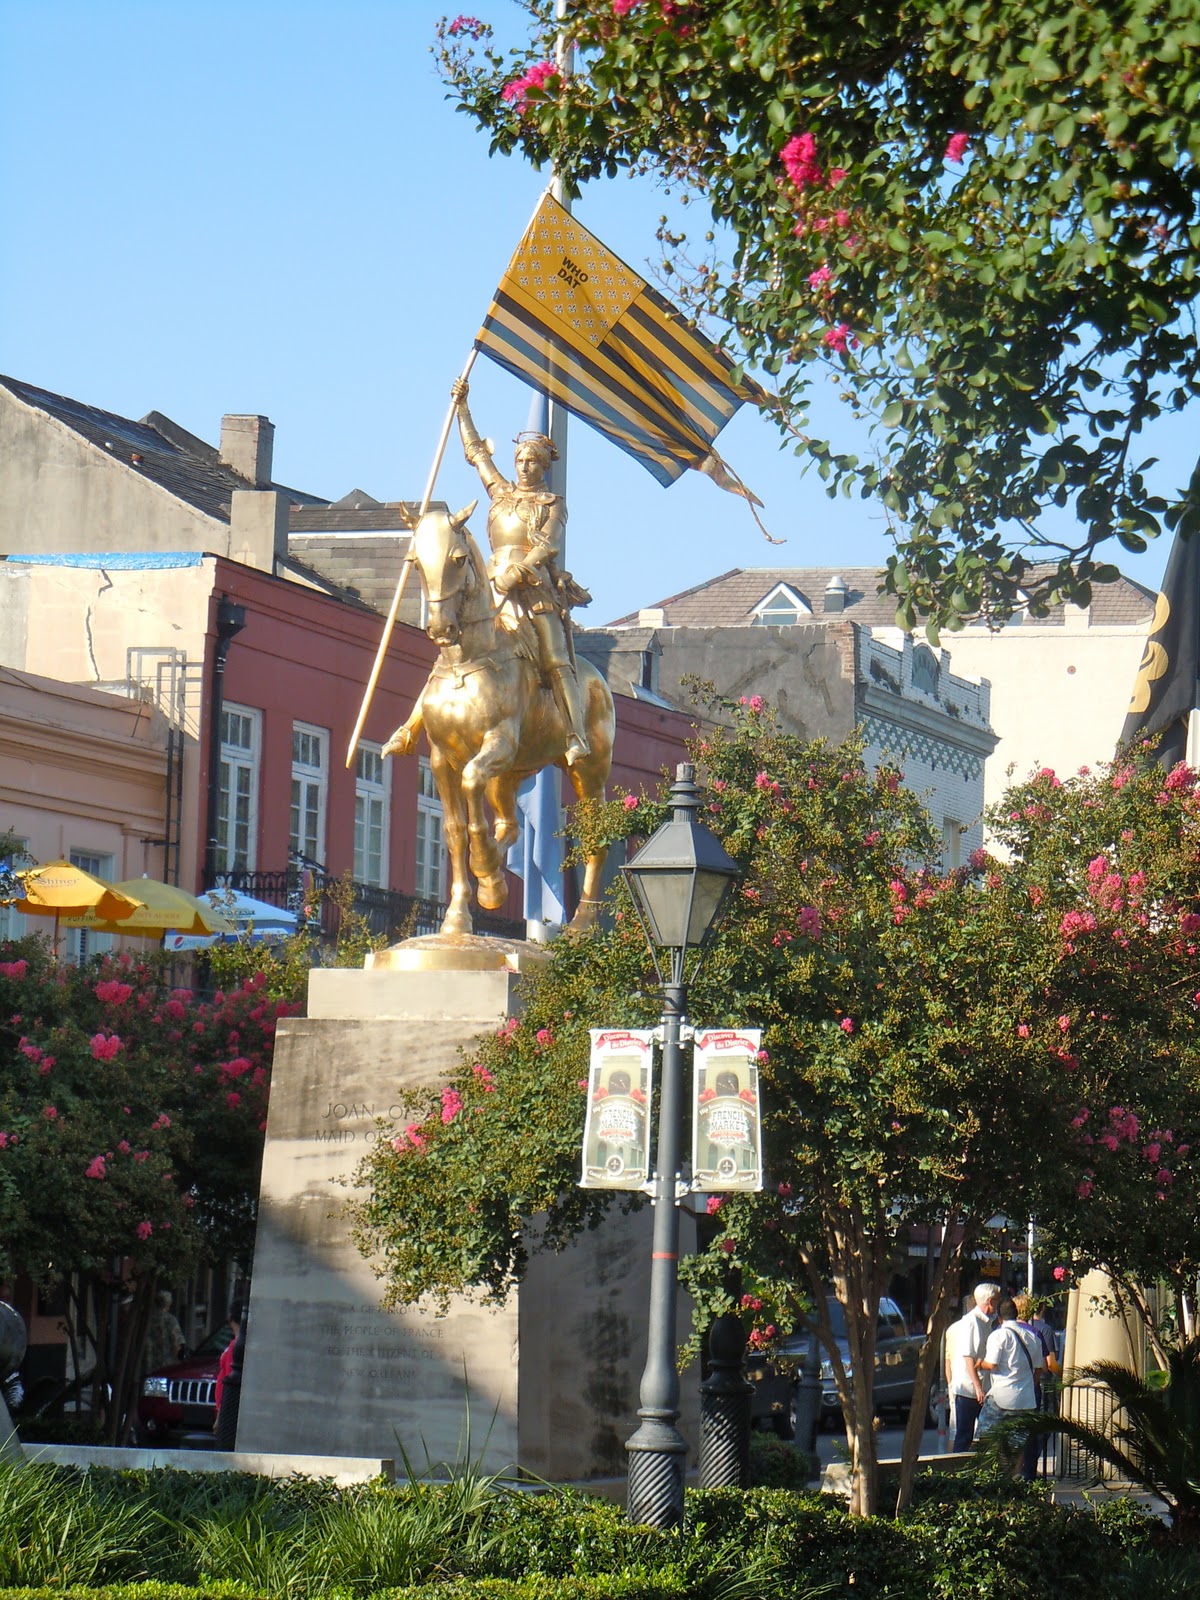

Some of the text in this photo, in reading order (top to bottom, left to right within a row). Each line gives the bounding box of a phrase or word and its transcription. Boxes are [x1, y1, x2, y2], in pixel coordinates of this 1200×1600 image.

[562, 256, 588, 282] WHO
[557, 268, 581, 289] DAT
[36, 876, 77, 885] Shiner
[603, 1033, 629, 1041] Discover
[707, 1033, 734, 1041] Discover
[620, 1039, 642, 1047] District
[725, 1039, 749, 1047] District
[321, 1103, 375, 1120] JOAN
[604, 1109, 633, 1120] FRENCH
[712, 1110, 744, 1121] FRENCH
[601, 1119, 635, 1129] MARKET
[711, 1120, 746, 1131] MARKET
[314, 1130, 356, 1144] MAID
[320, 1325, 445, 1339] THE PEOPLE OF FRANCE
[346, 1347, 366, 1358] THE
[342, 1368, 365, 1378] NEW
